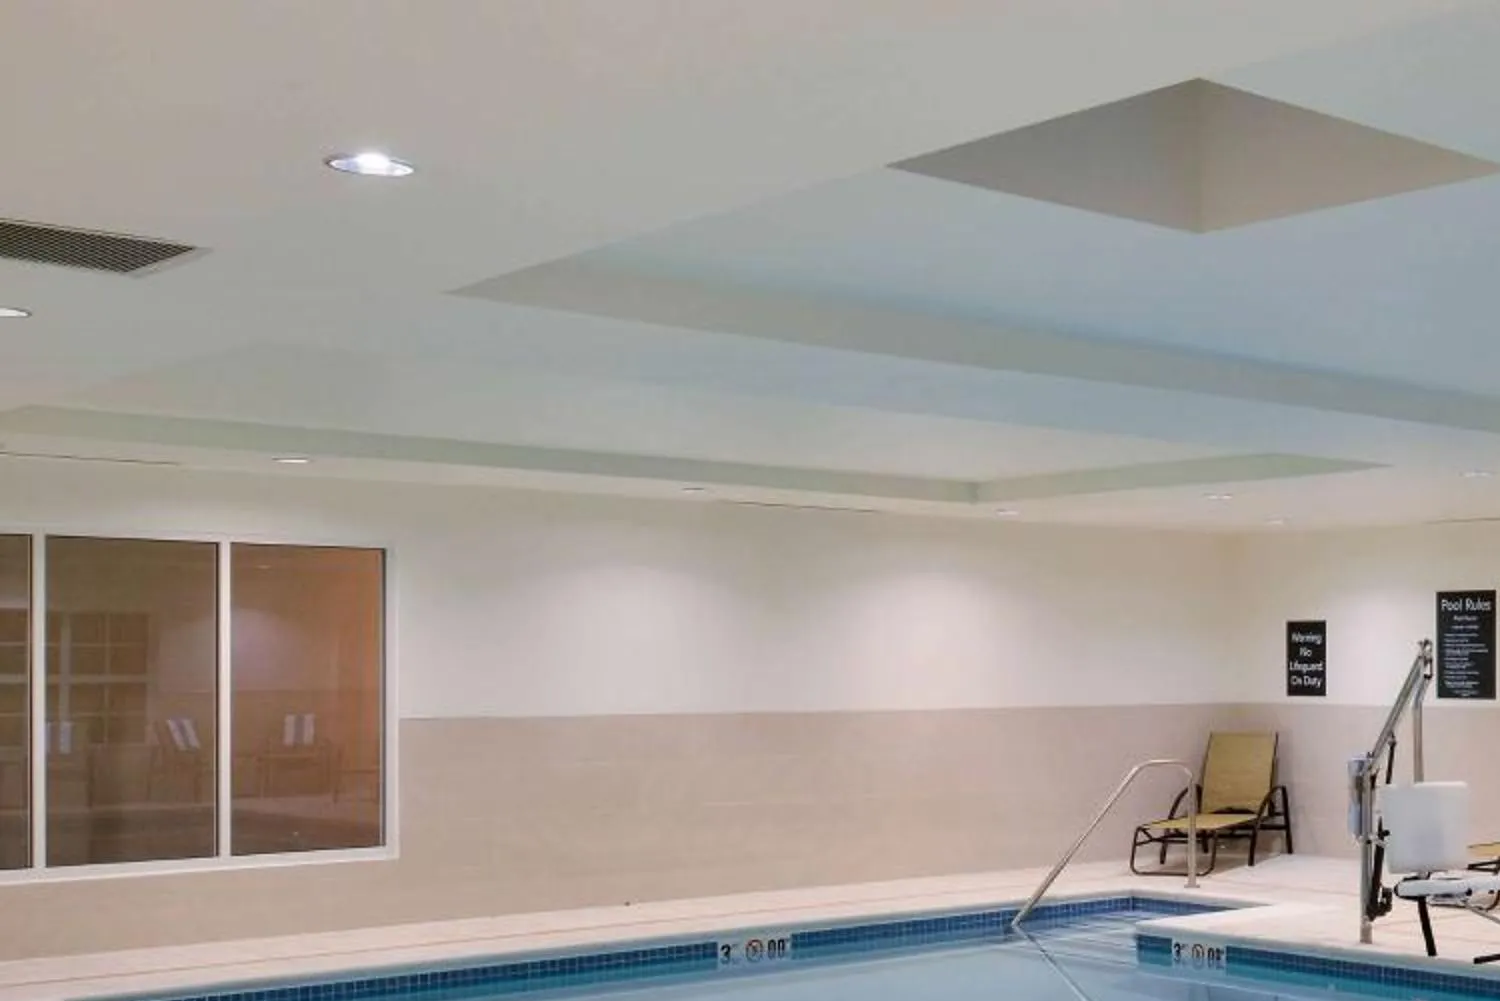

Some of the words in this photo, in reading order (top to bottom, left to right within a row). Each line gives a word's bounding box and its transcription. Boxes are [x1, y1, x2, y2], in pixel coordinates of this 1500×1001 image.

[1440, 598, 1463, 611] Pool
[1465, 597, 1492, 611] Rules
[1299, 647, 1312, 657] No
[1290, 675, 1302, 685] On
[1303, 675, 1322, 688] Duty
